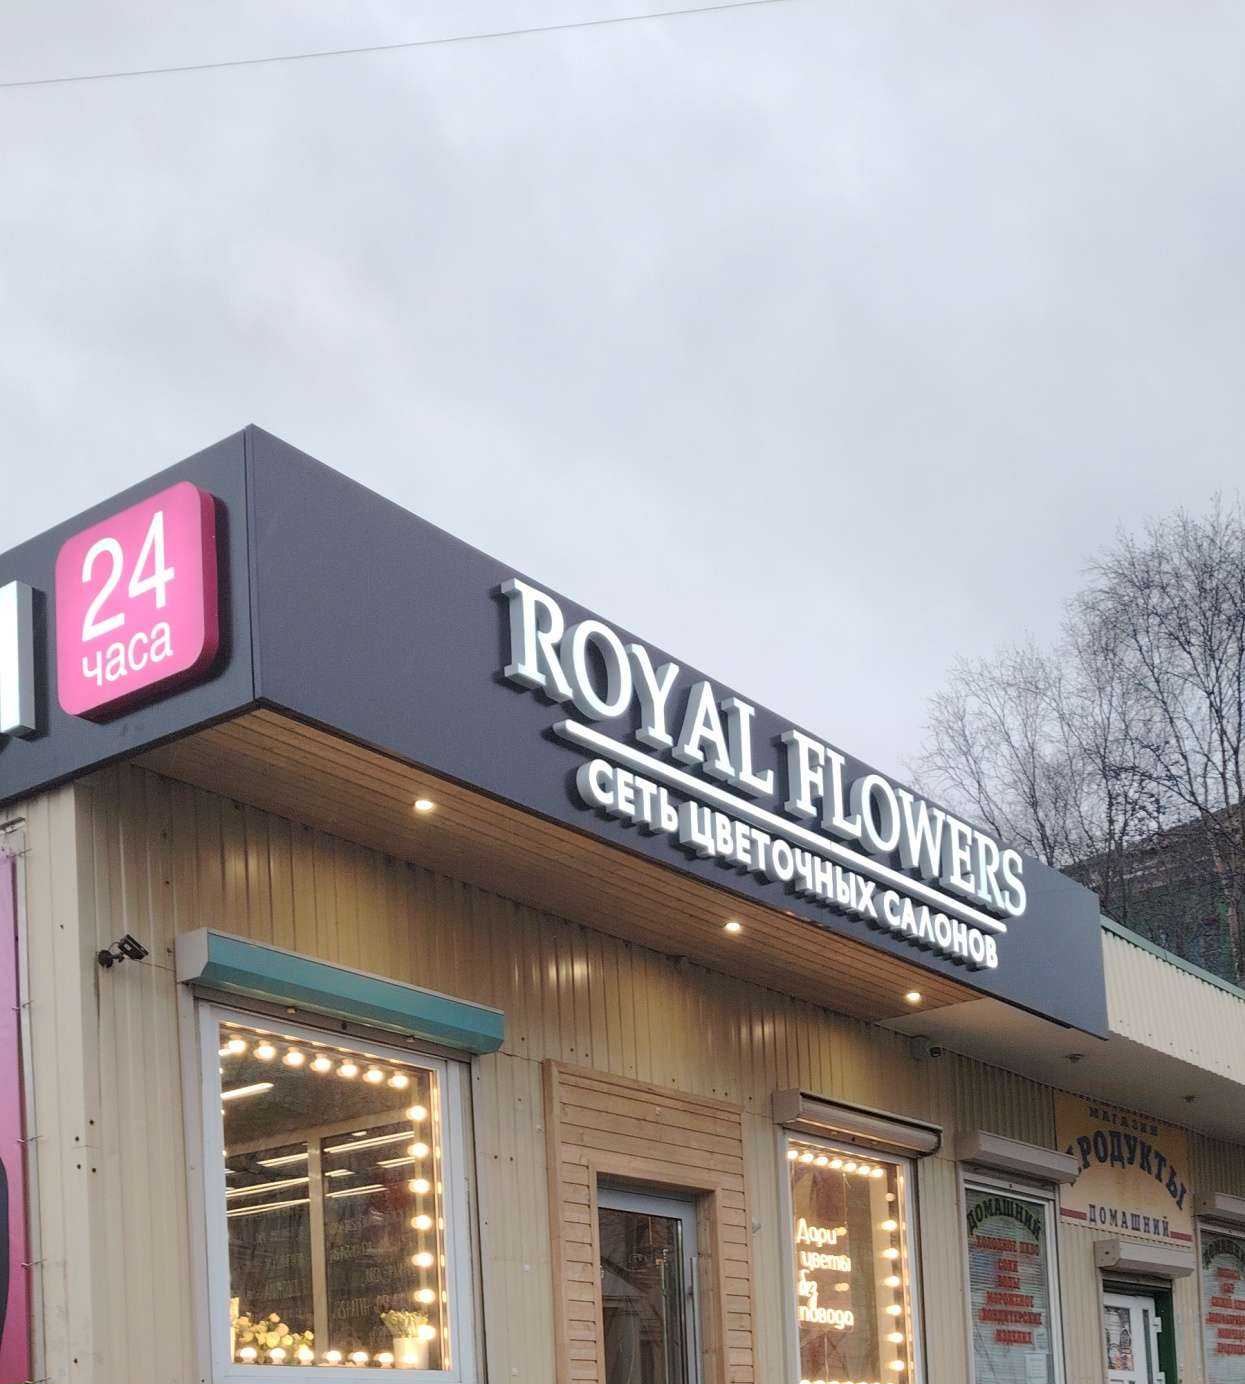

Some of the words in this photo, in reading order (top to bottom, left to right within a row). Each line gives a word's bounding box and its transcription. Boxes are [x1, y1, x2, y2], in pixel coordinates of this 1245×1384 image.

[81, 510, 176, 643] 24
[82, 621, 174, 687] часа
[500, 577, 774, 799] ROYAL
[779, 728, 1028, 919] FLOWERS
[576, 758, 679, 834] СЕТЬ
[678, 801, 878, 920] ЦВЕТОЧНЫХ
[875, 889, 1000, 969] САЛОНОВ
[967, 1197, 1043, 1241] ДОМАШНИЙ
[1088, 1203, 1170, 1238] ДОМАШНИЙ
